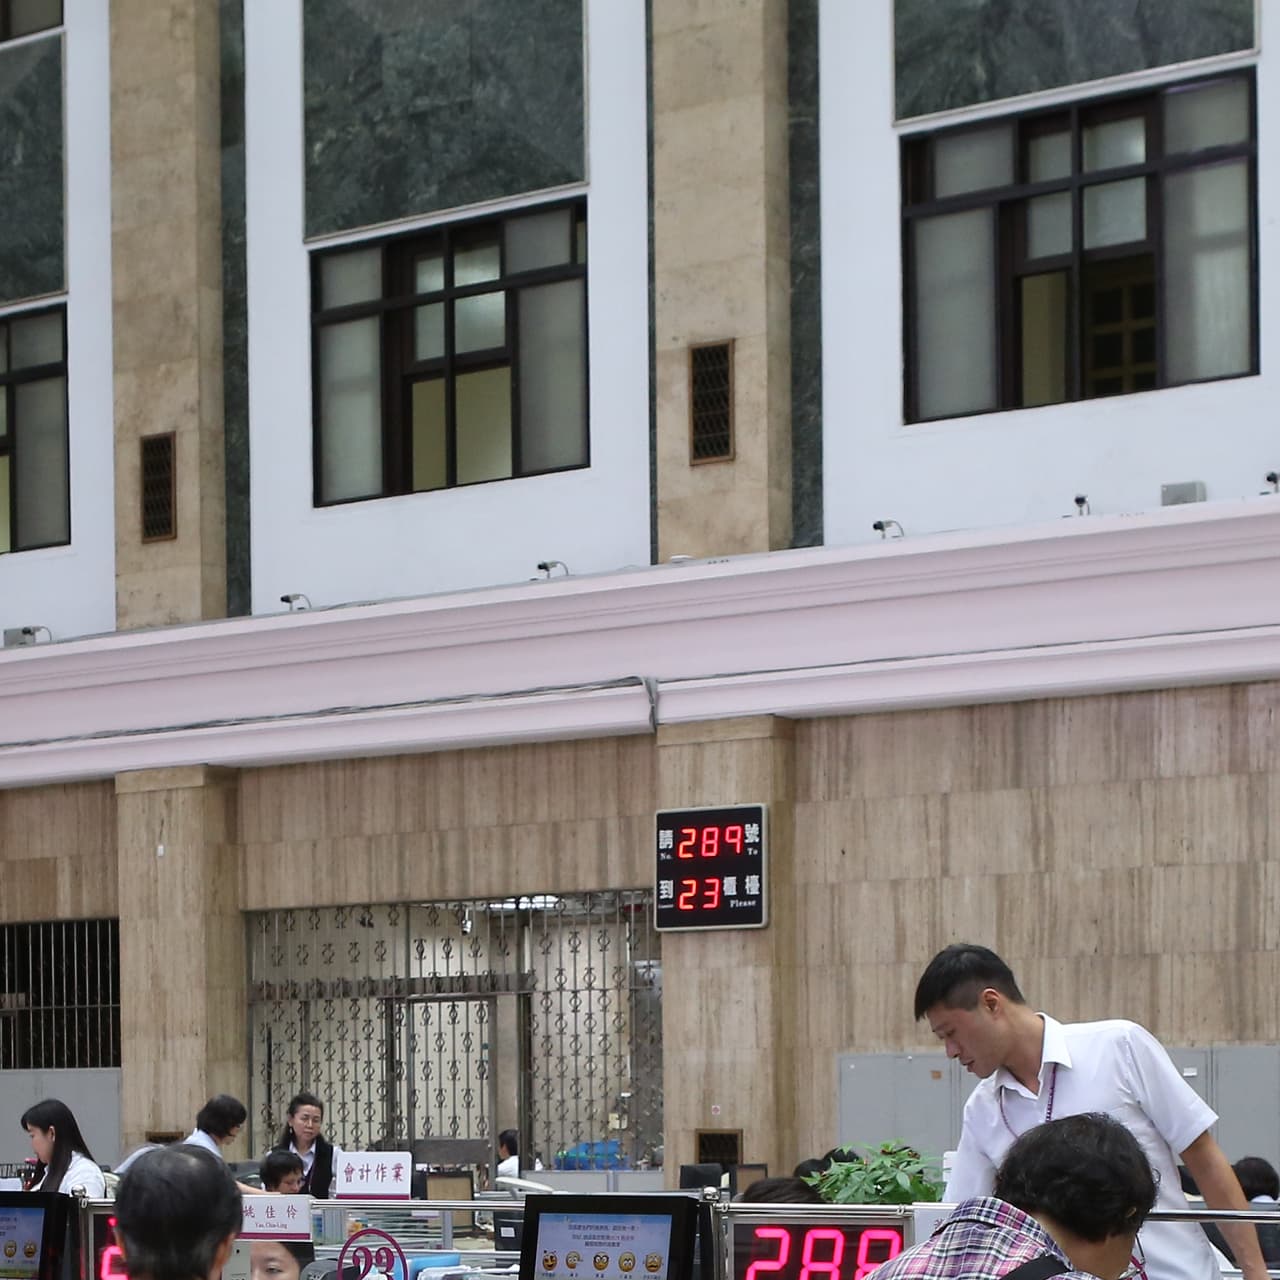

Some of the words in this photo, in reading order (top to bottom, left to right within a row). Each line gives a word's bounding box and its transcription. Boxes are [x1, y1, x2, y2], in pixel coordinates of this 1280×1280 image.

[678, 825, 742, 858] 289
[659, 879, 674, 899] 到
[679, 879, 719, 910] 23
[729, 899, 757, 909] Please
[343, 1162, 405, 1183] 會計作業
